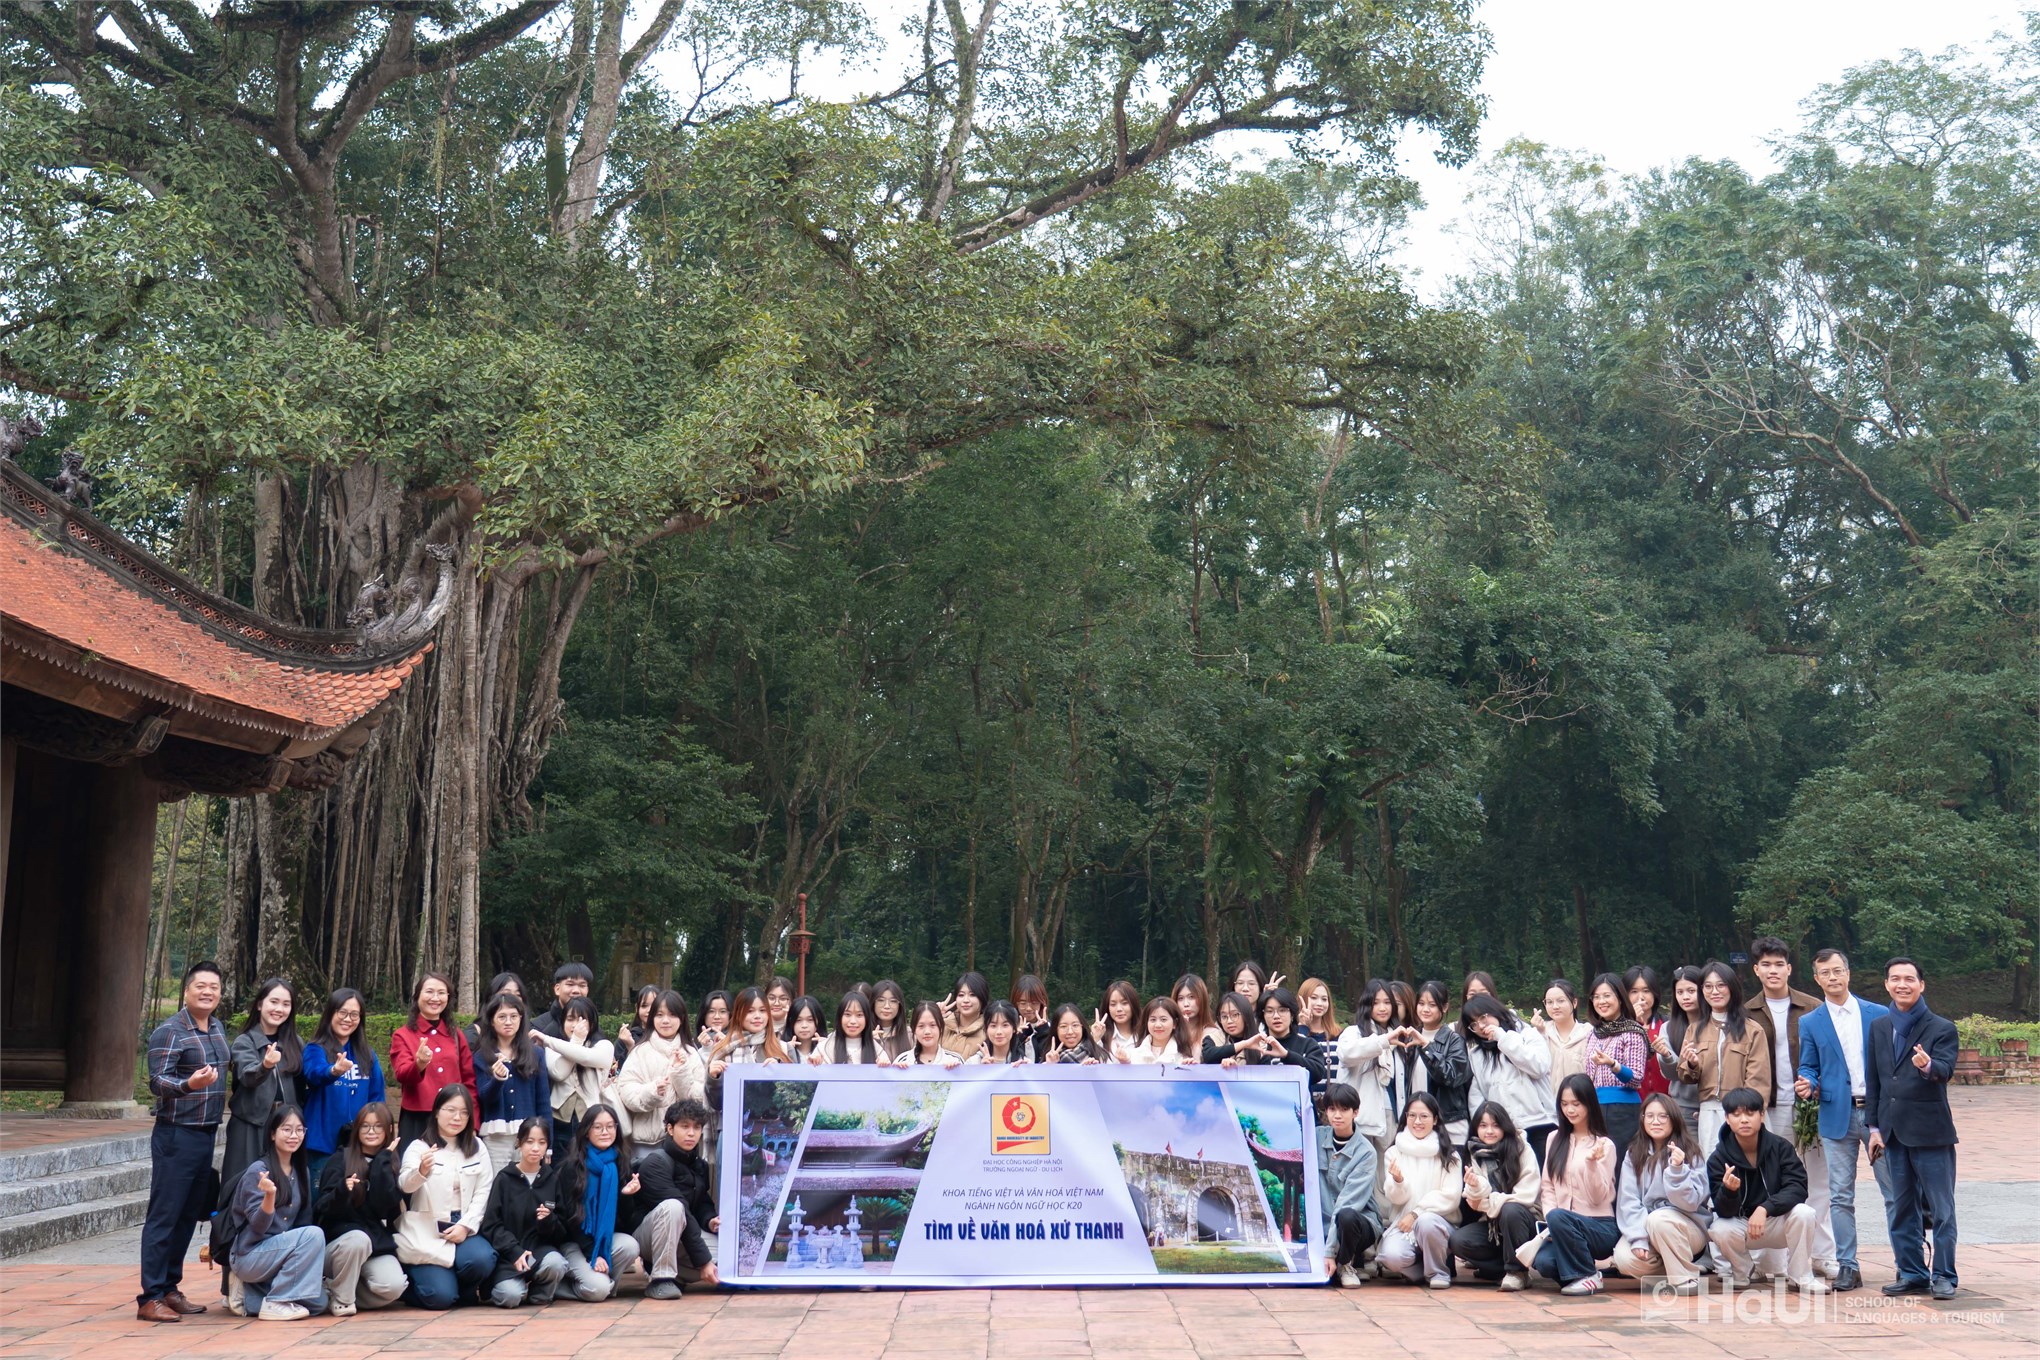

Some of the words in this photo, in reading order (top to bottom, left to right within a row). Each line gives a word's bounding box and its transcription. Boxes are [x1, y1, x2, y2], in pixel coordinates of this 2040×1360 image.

[1023, 1158, 1043, 1166] NGHIỆP
[1052, 1158, 1063, 1166] NỘI
[942, 1188, 966, 1197] KHOA
[968, 1186, 993, 1197] TIẾNG
[995, 1186, 1012, 1198] VIỆT
[1014, 1186, 1025, 1197] VÀ
[1026, 1186, 1044, 1197] VĂN
[1045, 1186, 1064, 1197] HOÁ
[1065, 1186, 1083, 1198] VIỆT
[1084, 1188, 1104, 1196] NAM
[964, 1200, 996, 1210] NGÀNH
[997, 1200, 1023, 1210] NGÔN
[1025, 1200, 1045, 1210] NGỮ
[1046, 1201, 1065, 1211] HỌC
[1067, 1201, 1083, 1210] K20
[923, 1219, 953, 1240] TÌM
[957, 1216, 977, 1240] VỀ
[980, 1219, 1011, 1240] VĂN
[1015, 1219, 1046, 1240] HOÁ
[1050, 1219, 1071, 1240] XỨ
[1074, 1222, 1124, 1240] THANH
